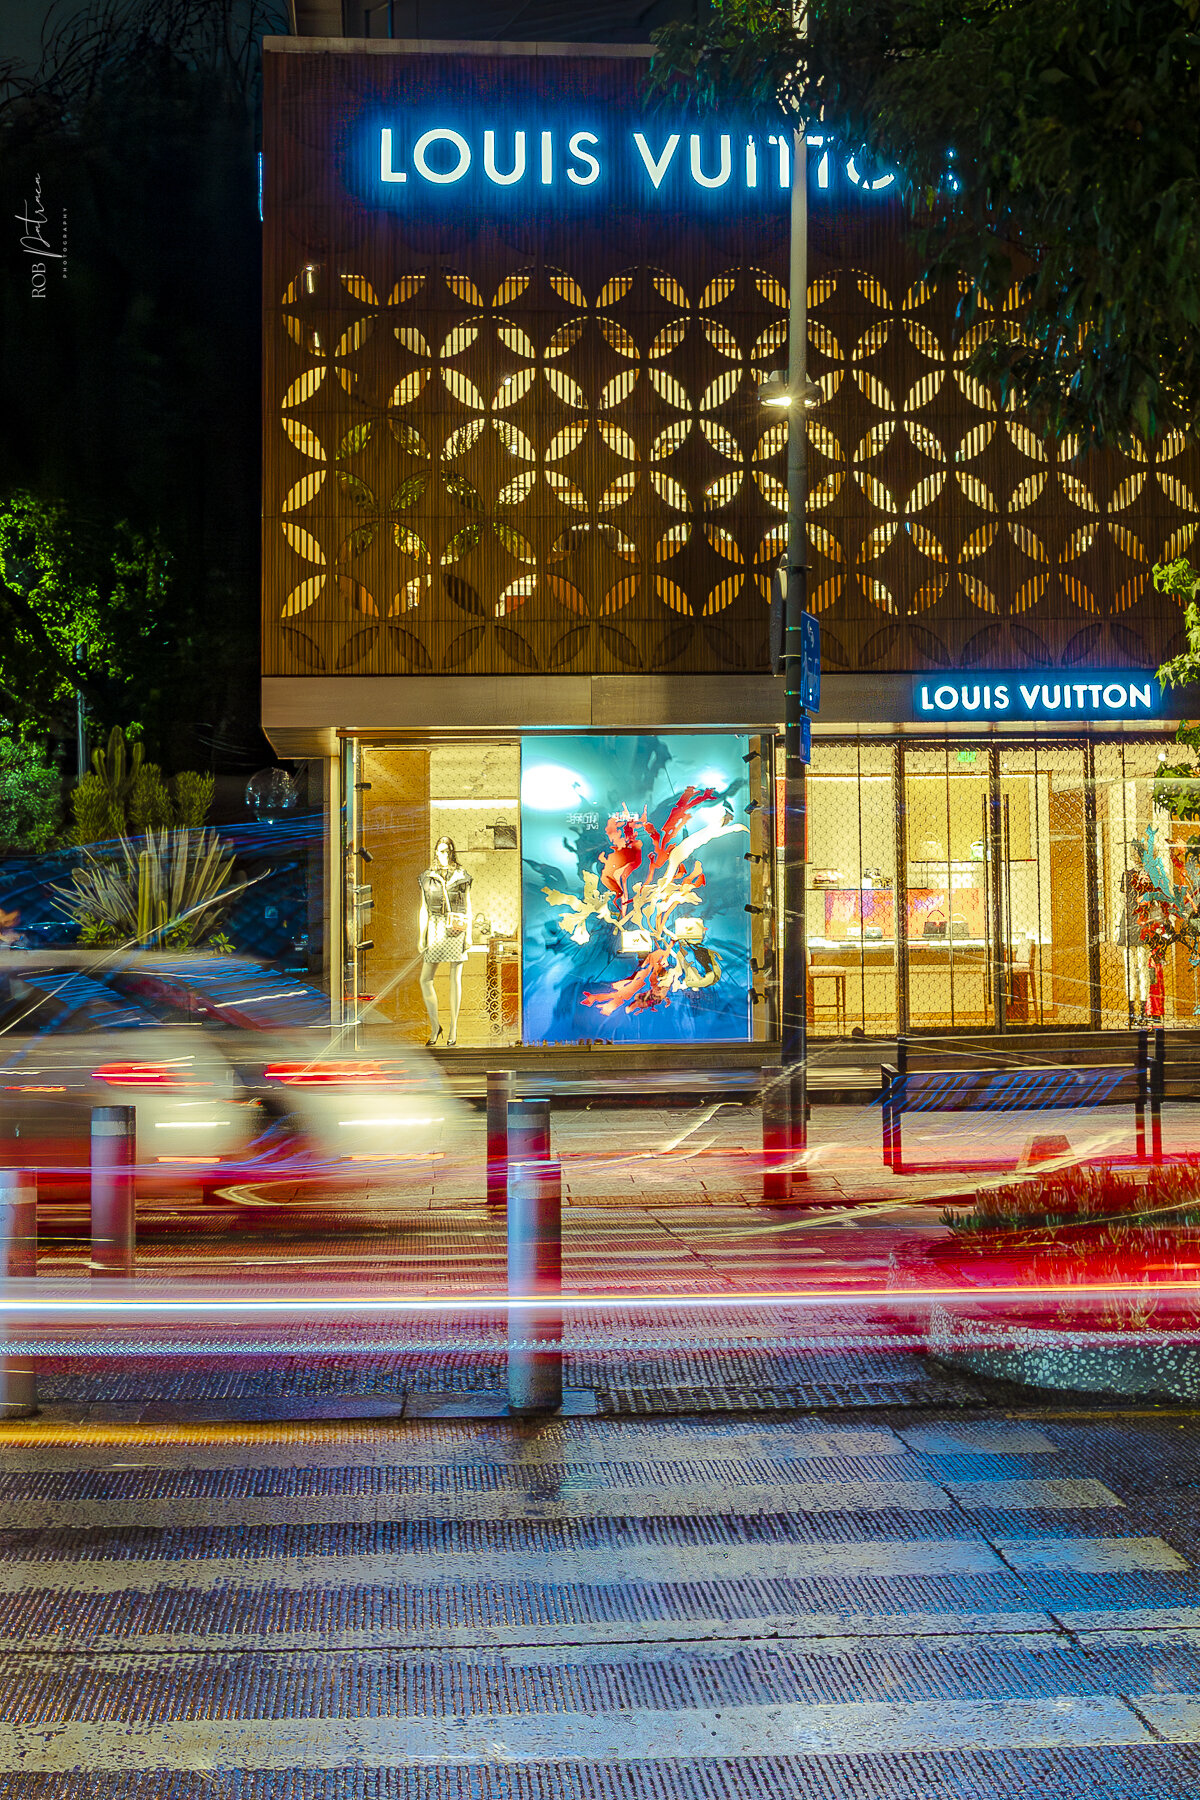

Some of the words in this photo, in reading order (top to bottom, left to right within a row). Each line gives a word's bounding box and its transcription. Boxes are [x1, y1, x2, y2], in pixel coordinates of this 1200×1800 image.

[380, 127, 600, 187] LOUIS
[632, 132, 957, 190] VUITT
[921, 685, 1009, 711] LOUIS
[1019, 684, 1152, 711] VUITTON
